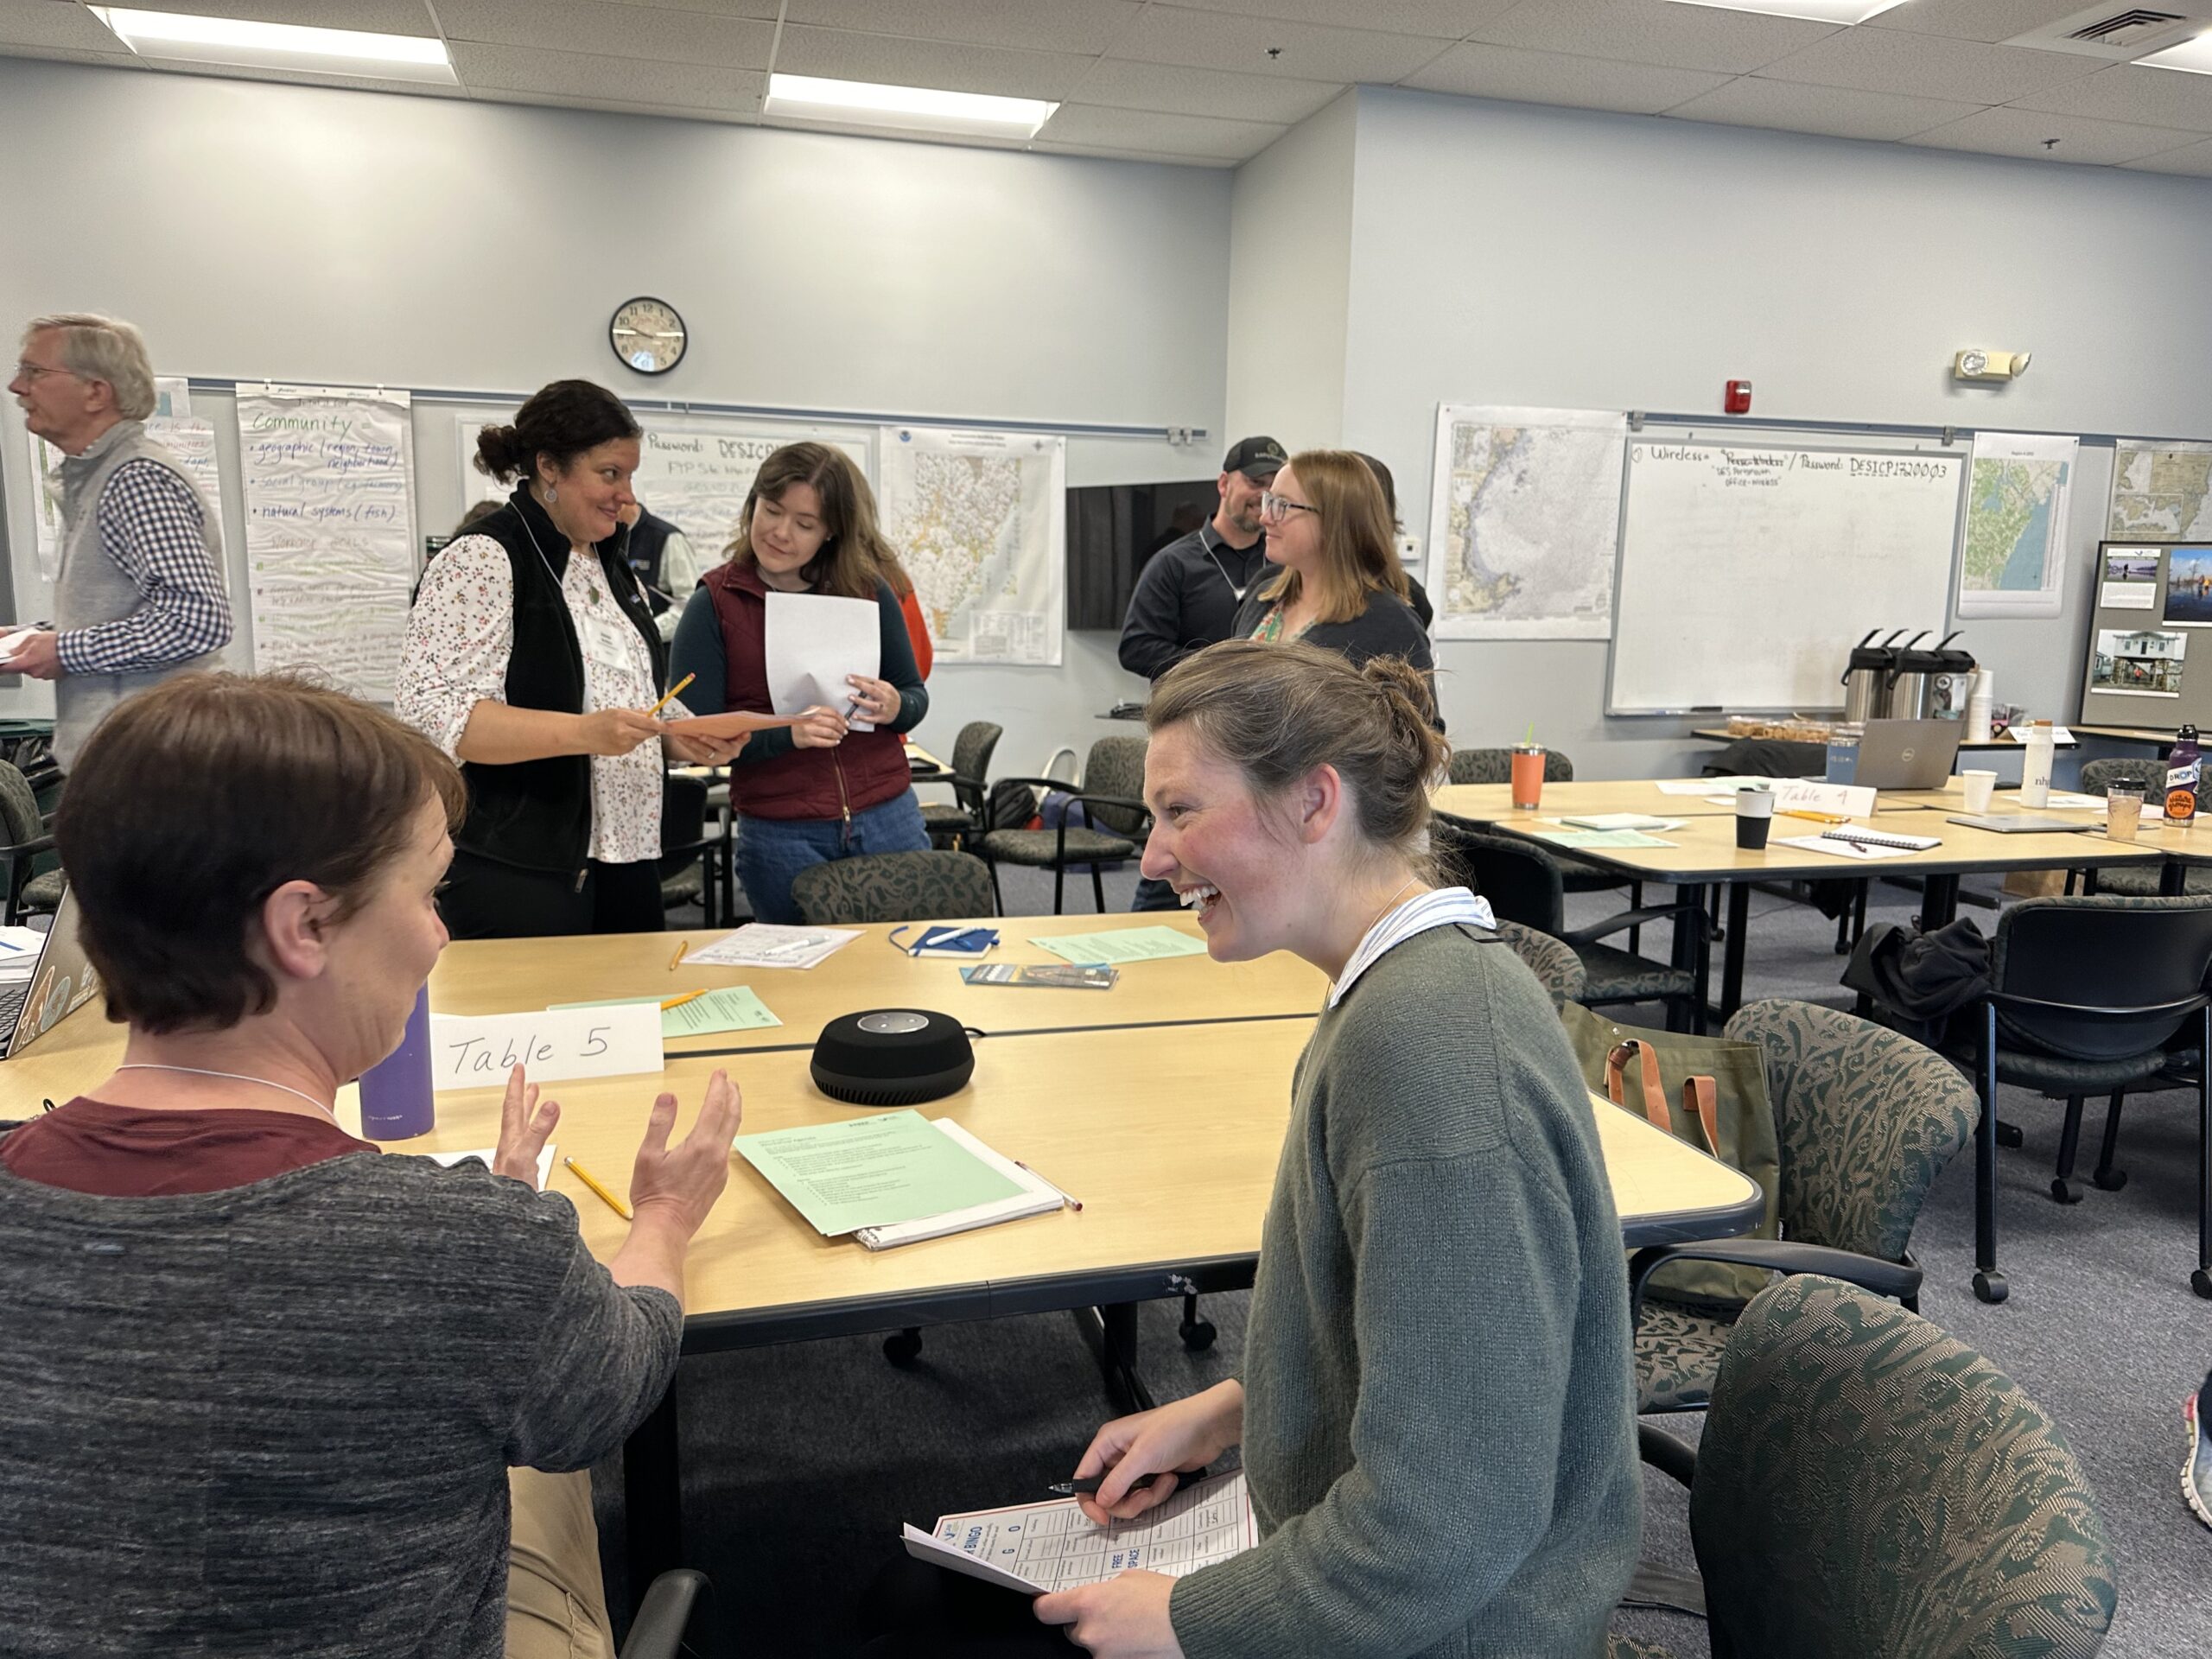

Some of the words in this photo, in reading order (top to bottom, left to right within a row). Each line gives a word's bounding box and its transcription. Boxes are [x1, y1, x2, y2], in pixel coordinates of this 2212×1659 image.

[629, 307, 638, 316] 11
[643, 303, 653, 313] 12
[658, 308, 664, 317] 1
[619, 316, 629, 326] 10
[669, 319, 676, 328] 2
[670, 346, 677, 355] 4
[660, 357, 667, 366] 5
[253, 412, 353, 441] Community
[254, 442, 313, 465] geographic
[718, 439, 779, 460] DESICP
[262, 502, 304, 518] natural
[2169, 770, 2192, 781] DROP
[1783, 785, 1822, 802] Table
[449, 1033, 555, 1075] Table
[580, 1027, 611, 1058] 5
[963, 1526, 982, 1549] BINGO
[1112, 1554, 1124, 1569] FREE
[1127, 1548, 1141, 1568] SPACE
